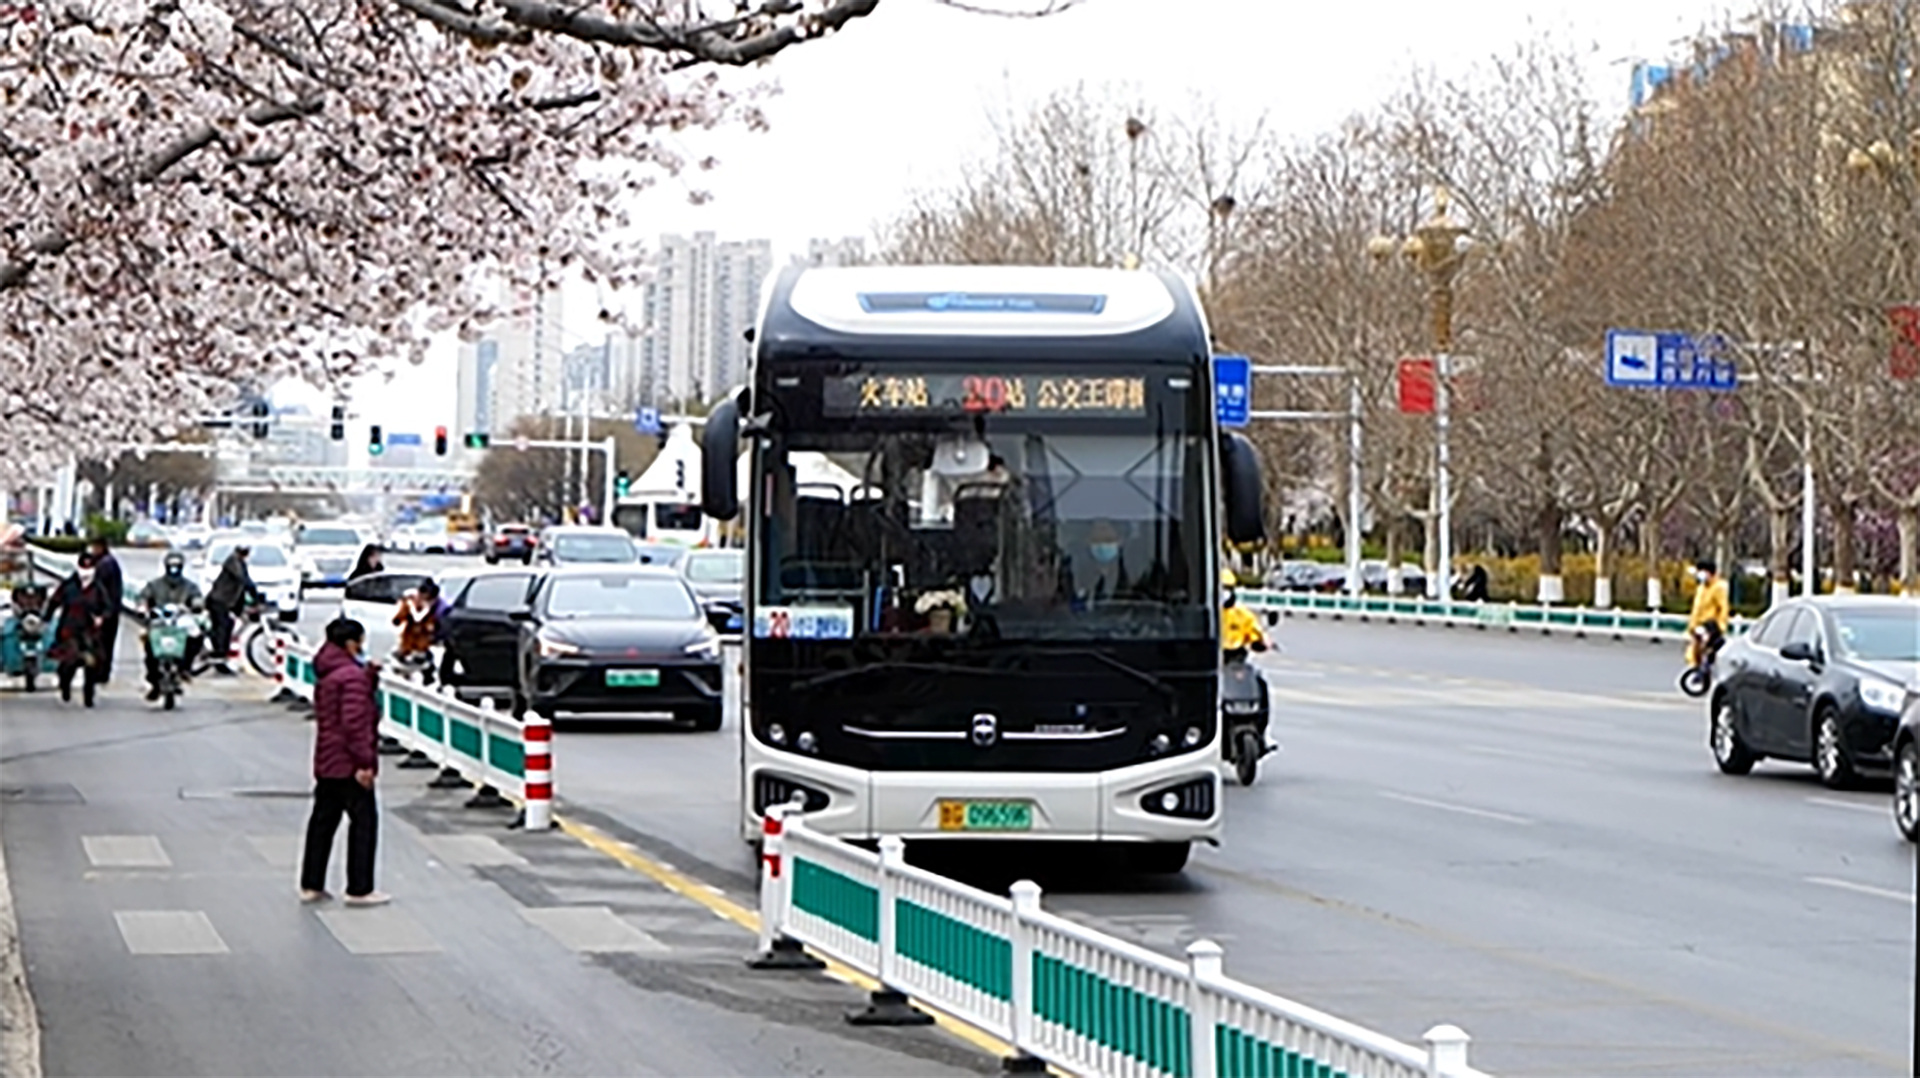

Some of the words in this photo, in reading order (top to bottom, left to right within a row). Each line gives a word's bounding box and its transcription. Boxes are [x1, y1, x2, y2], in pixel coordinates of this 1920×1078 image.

[860, 377, 928, 409] 火车站
[962, 375, 1006, 411] 20
